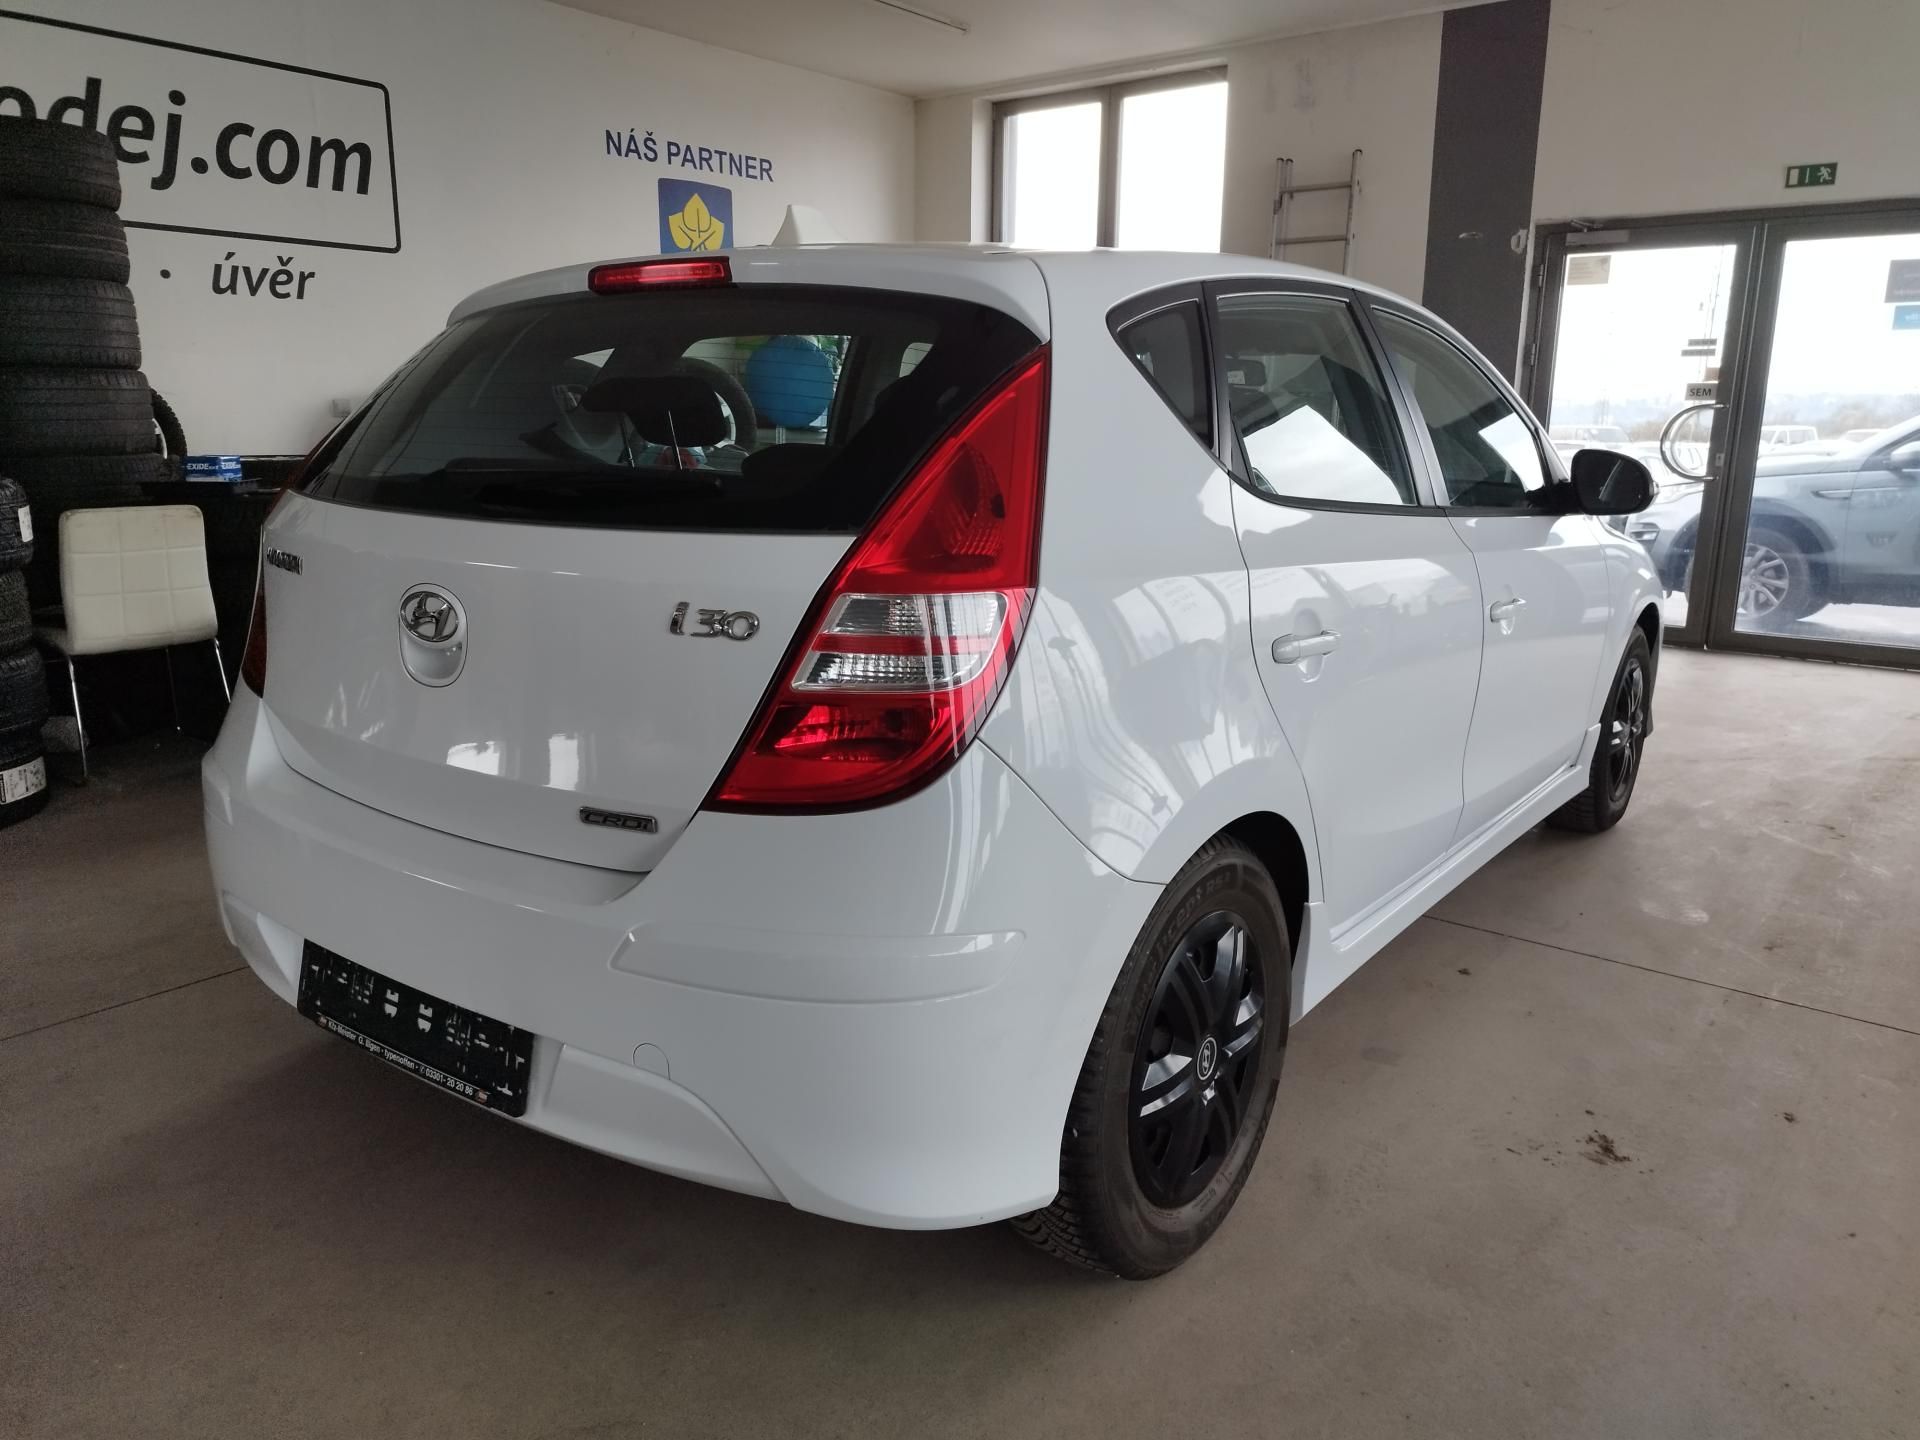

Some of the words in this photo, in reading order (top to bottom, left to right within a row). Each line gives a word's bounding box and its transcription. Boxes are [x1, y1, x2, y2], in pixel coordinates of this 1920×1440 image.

[605, 127, 658, 163] NÁŠ
[667, 141, 774, 182] PARTNER
[212, 251, 315, 301] úvěr
[1689, 387, 1712, 397] SEM
[669, 601, 760, 642] i30
[447, 1077, 455, 1089] 20
[455, 1080, 464, 1092] 20
